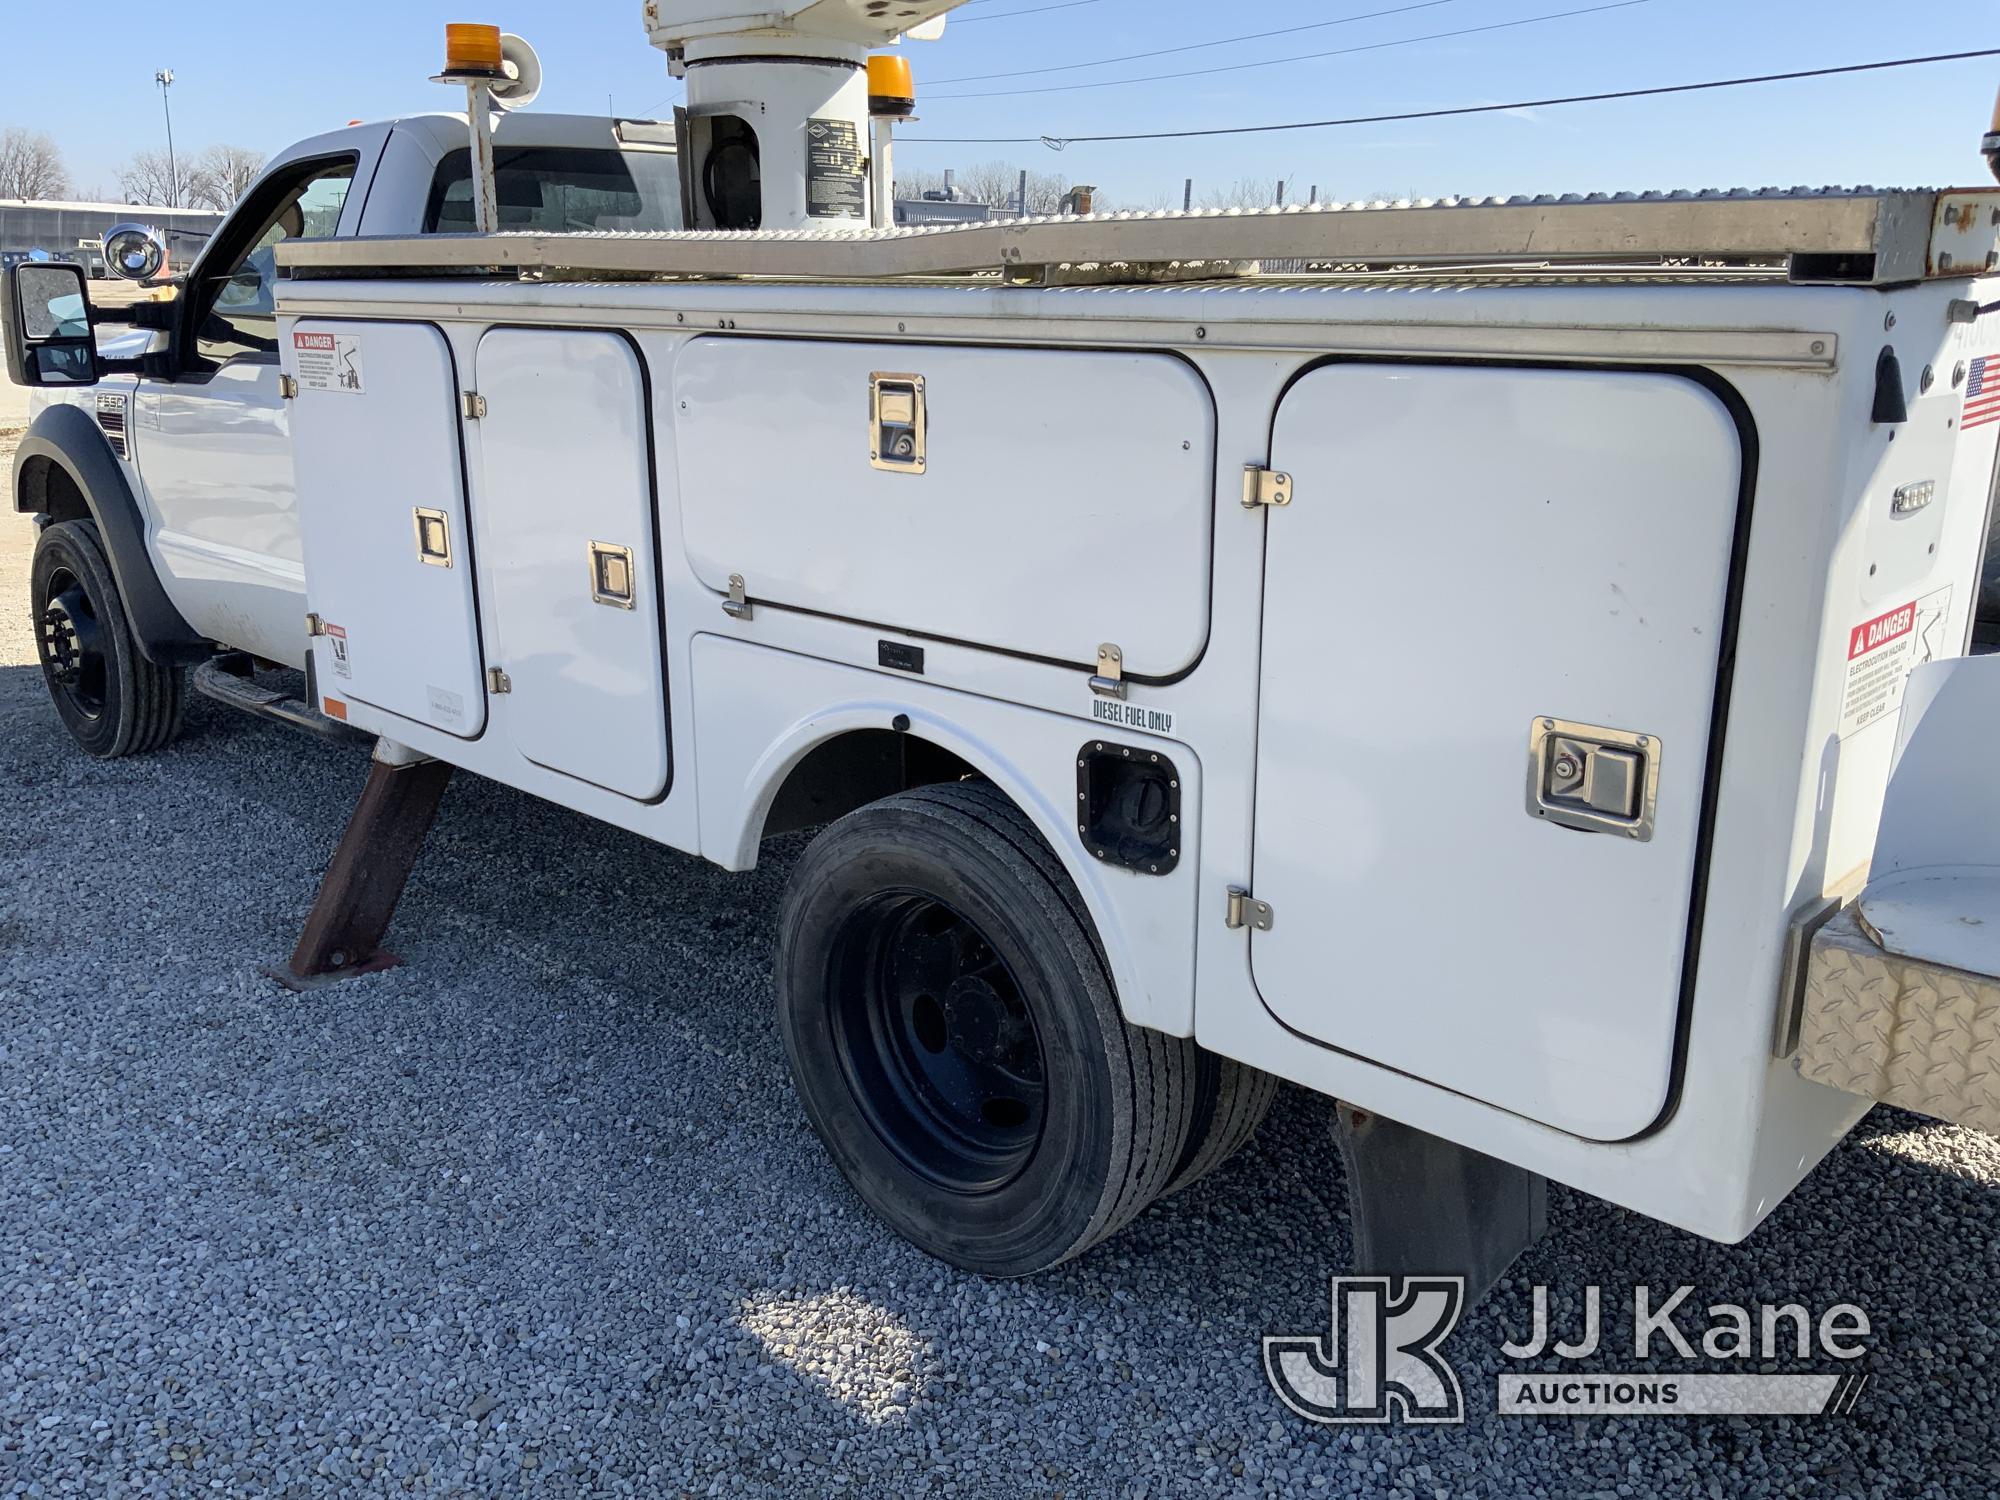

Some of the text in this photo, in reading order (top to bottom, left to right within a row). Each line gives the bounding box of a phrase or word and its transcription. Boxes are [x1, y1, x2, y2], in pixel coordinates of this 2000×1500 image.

[304, 335, 333, 348] DANGER
[1867, 607, 1911, 648] DANGER
[1849, 640, 1907, 677] ELECTROCUTION HAZARD
[1093, 699, 1172, 733] DIESEL FUEL ONLY
[1856, 702, 1886, 726] KEEP CLEAR
